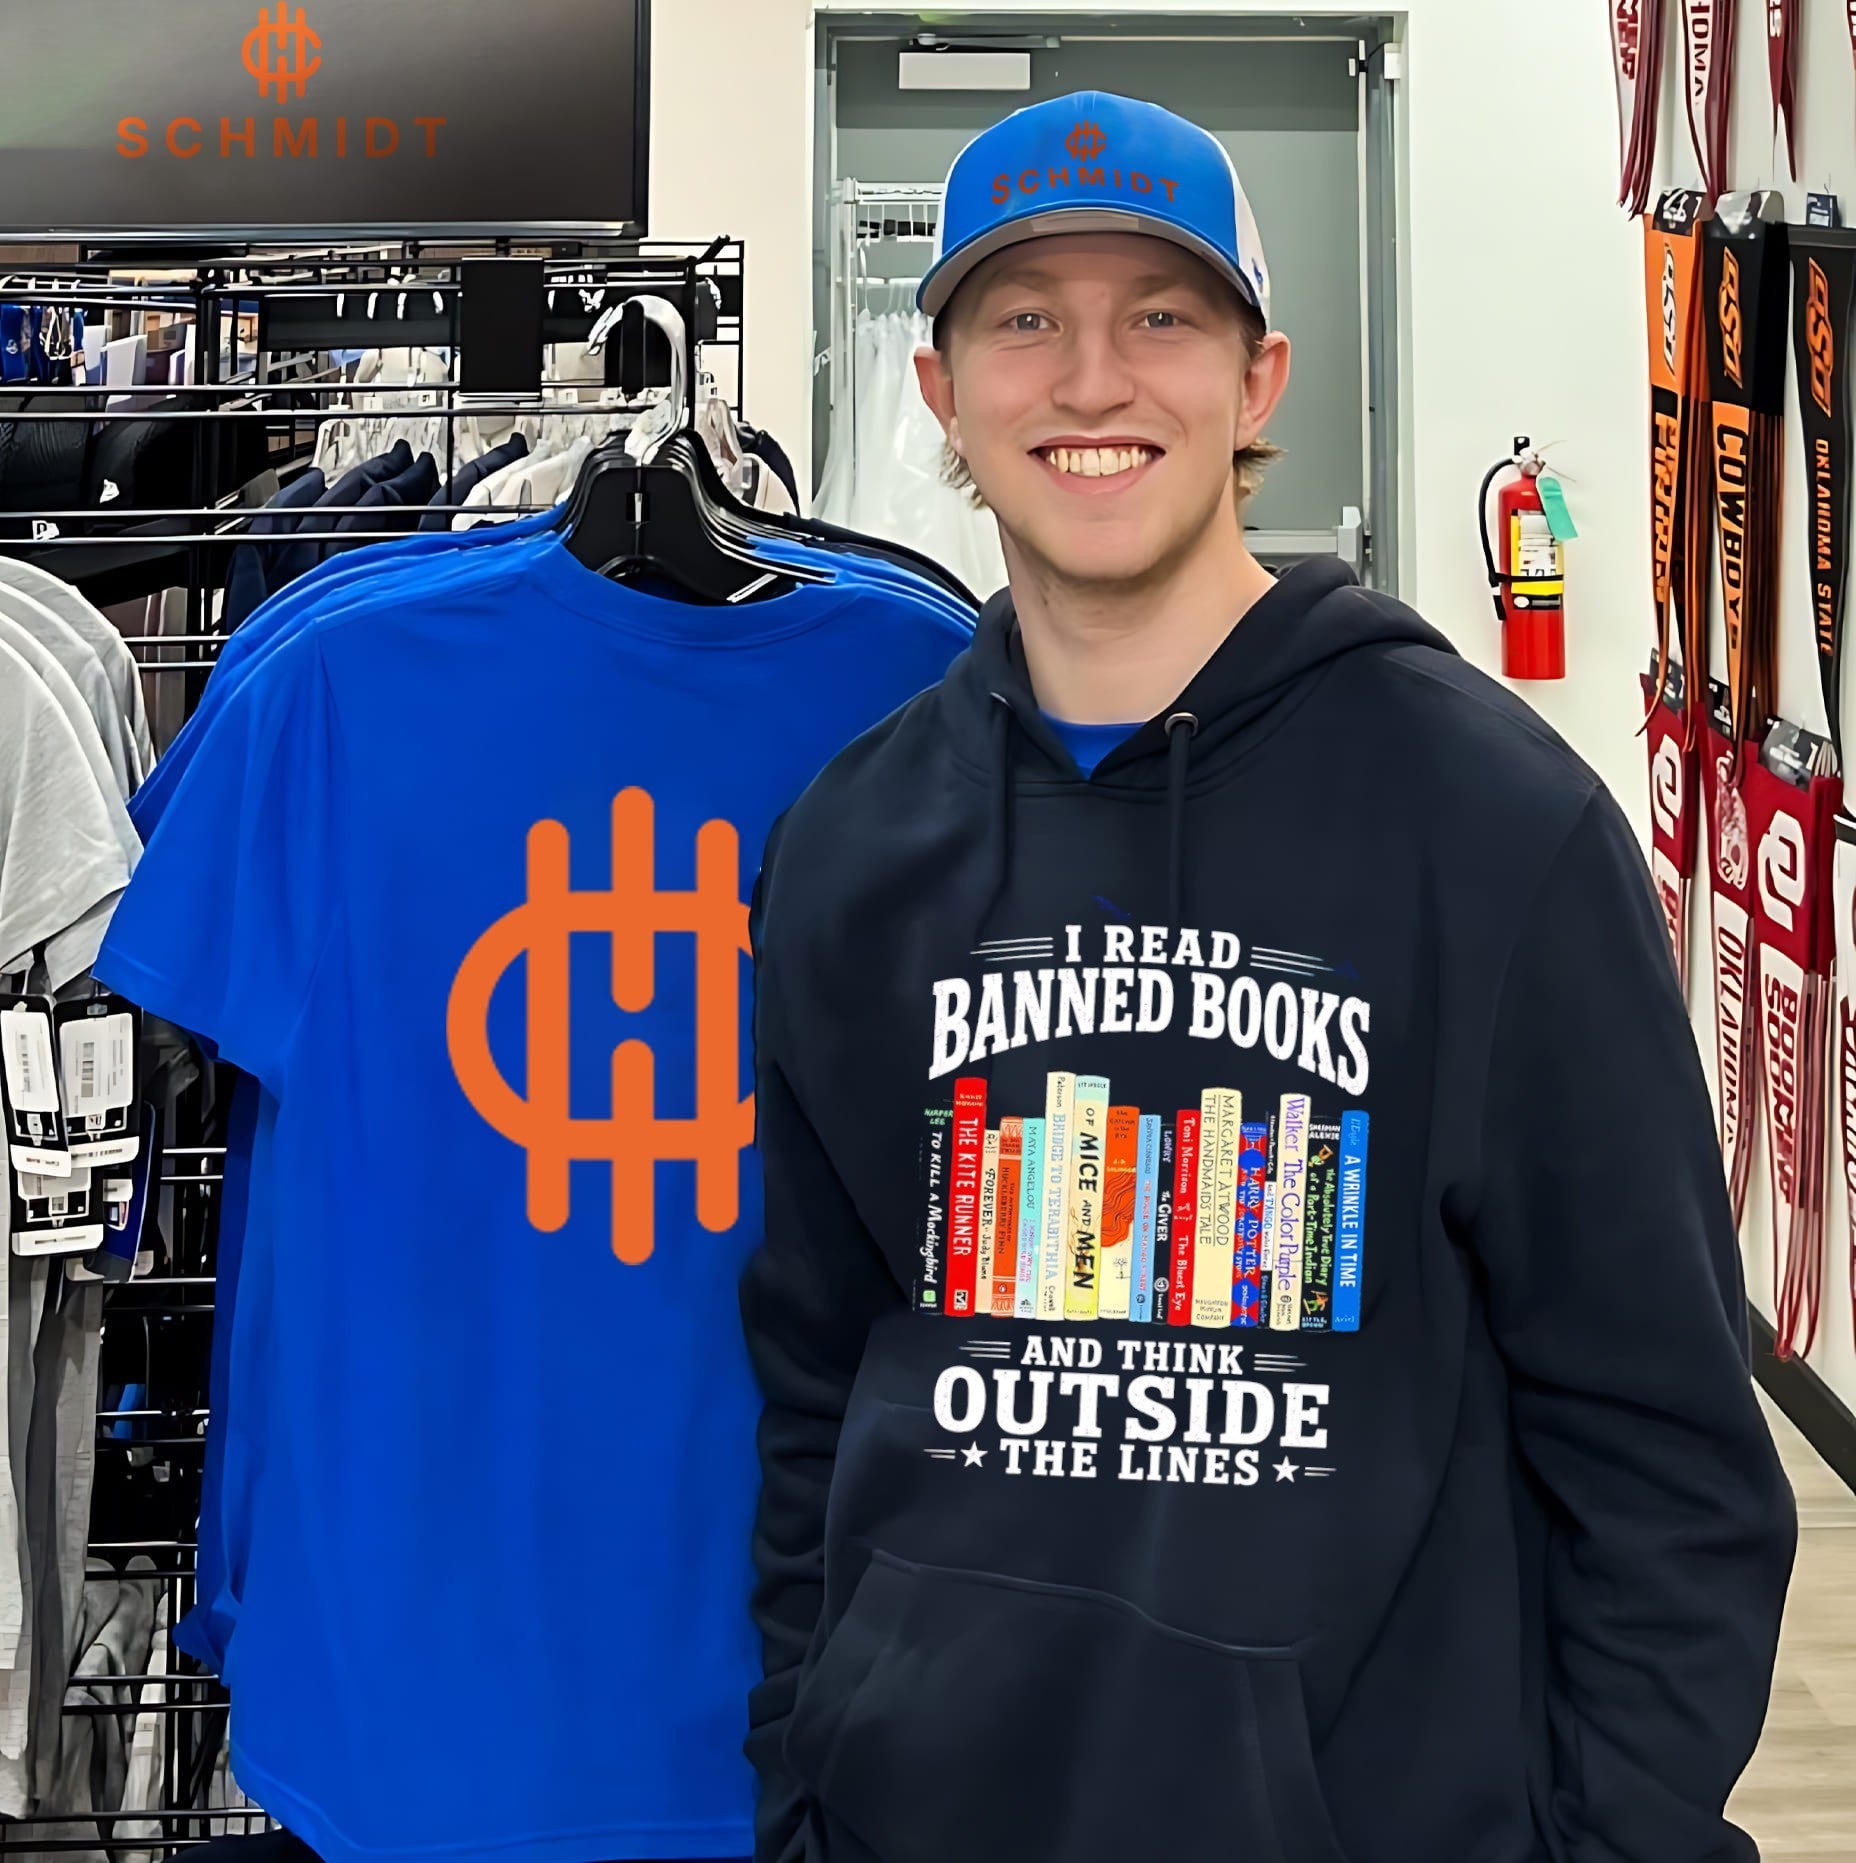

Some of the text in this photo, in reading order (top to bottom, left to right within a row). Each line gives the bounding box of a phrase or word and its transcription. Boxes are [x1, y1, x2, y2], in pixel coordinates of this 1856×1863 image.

[116, 117, 447, 158] SCHMIDT
[991, 167, 1179, 204] SCHMIDT
[1815, 438, 1833, 571] OKLAHOMA
[1065, 925, 1241, 970] I READ
[929, 967, 1371, 1097] BANNED BOOKS
[1085, 1107, 1095, 1126] OF
[1183, 1117, 1196, 1142] Toni
[1203, 1094, 1217, 1124] THE
[1284, 1097, 1305, 1152] Walker
[958, 1117, 979, 1146] THE
[1162, 1130, 1173, 1163] LOWRY
[955, 1153, 977, 1188] KITE
[1026, 1126, 1037, 1209] MAYA ANGELOU
[1077, 1131, 1100, 1193] MICE
[1180, 1146, 1194, 1194] Morrison
[1216, 1095, 1235, 1246] MARGARET ATWOOD
[1283, 1159, 1304, 1189] The
[919, 1131, 944, 1284] TO KILL A Mockingbird
[1044, 1113, 1066, 1280] BRIDGE TO TERABITHIA
[1081, 1199, 1092, 1227] AND
[1263, 1197, 1276, 1229] TANGO
[1280, 1193, 1301, 1241] Color
[1320, 1182, 1336, 1233] Absolutely
[952, 1194, 975, 1256] RUNNER
[1156, 1203, 1172, 1242] GIVER
[1199, 1214, 1212, 1245] TALE
[1245, 1166, 1261, 1277] HARRY POTTER
[1304, 1194, 1320, 1245] Part-Time
[1339, 1155, 1361, 1288] A WRINKLE IN TIME
[1072, 1229, 1096, 1290] MEN
[1178, 1235, 1189, 1255] The
[1304, 1246, 1318, 1284] Indian
[1320, 1234, 1333, 1255] True
[1175, 1259, 1188, 1289] Bluest
[1275, 1244, 1299, 1291] Purple
[1315, 1255, 1332, 1286] Diary
[1172, 1292, 1186, 1311] Eye
[1020, 1335, 1244, 1375] AND THINK
[932, 1365, 1331, 1449] OUTSIDE
[1000, 1438, 1260, 1486] THE LINES
